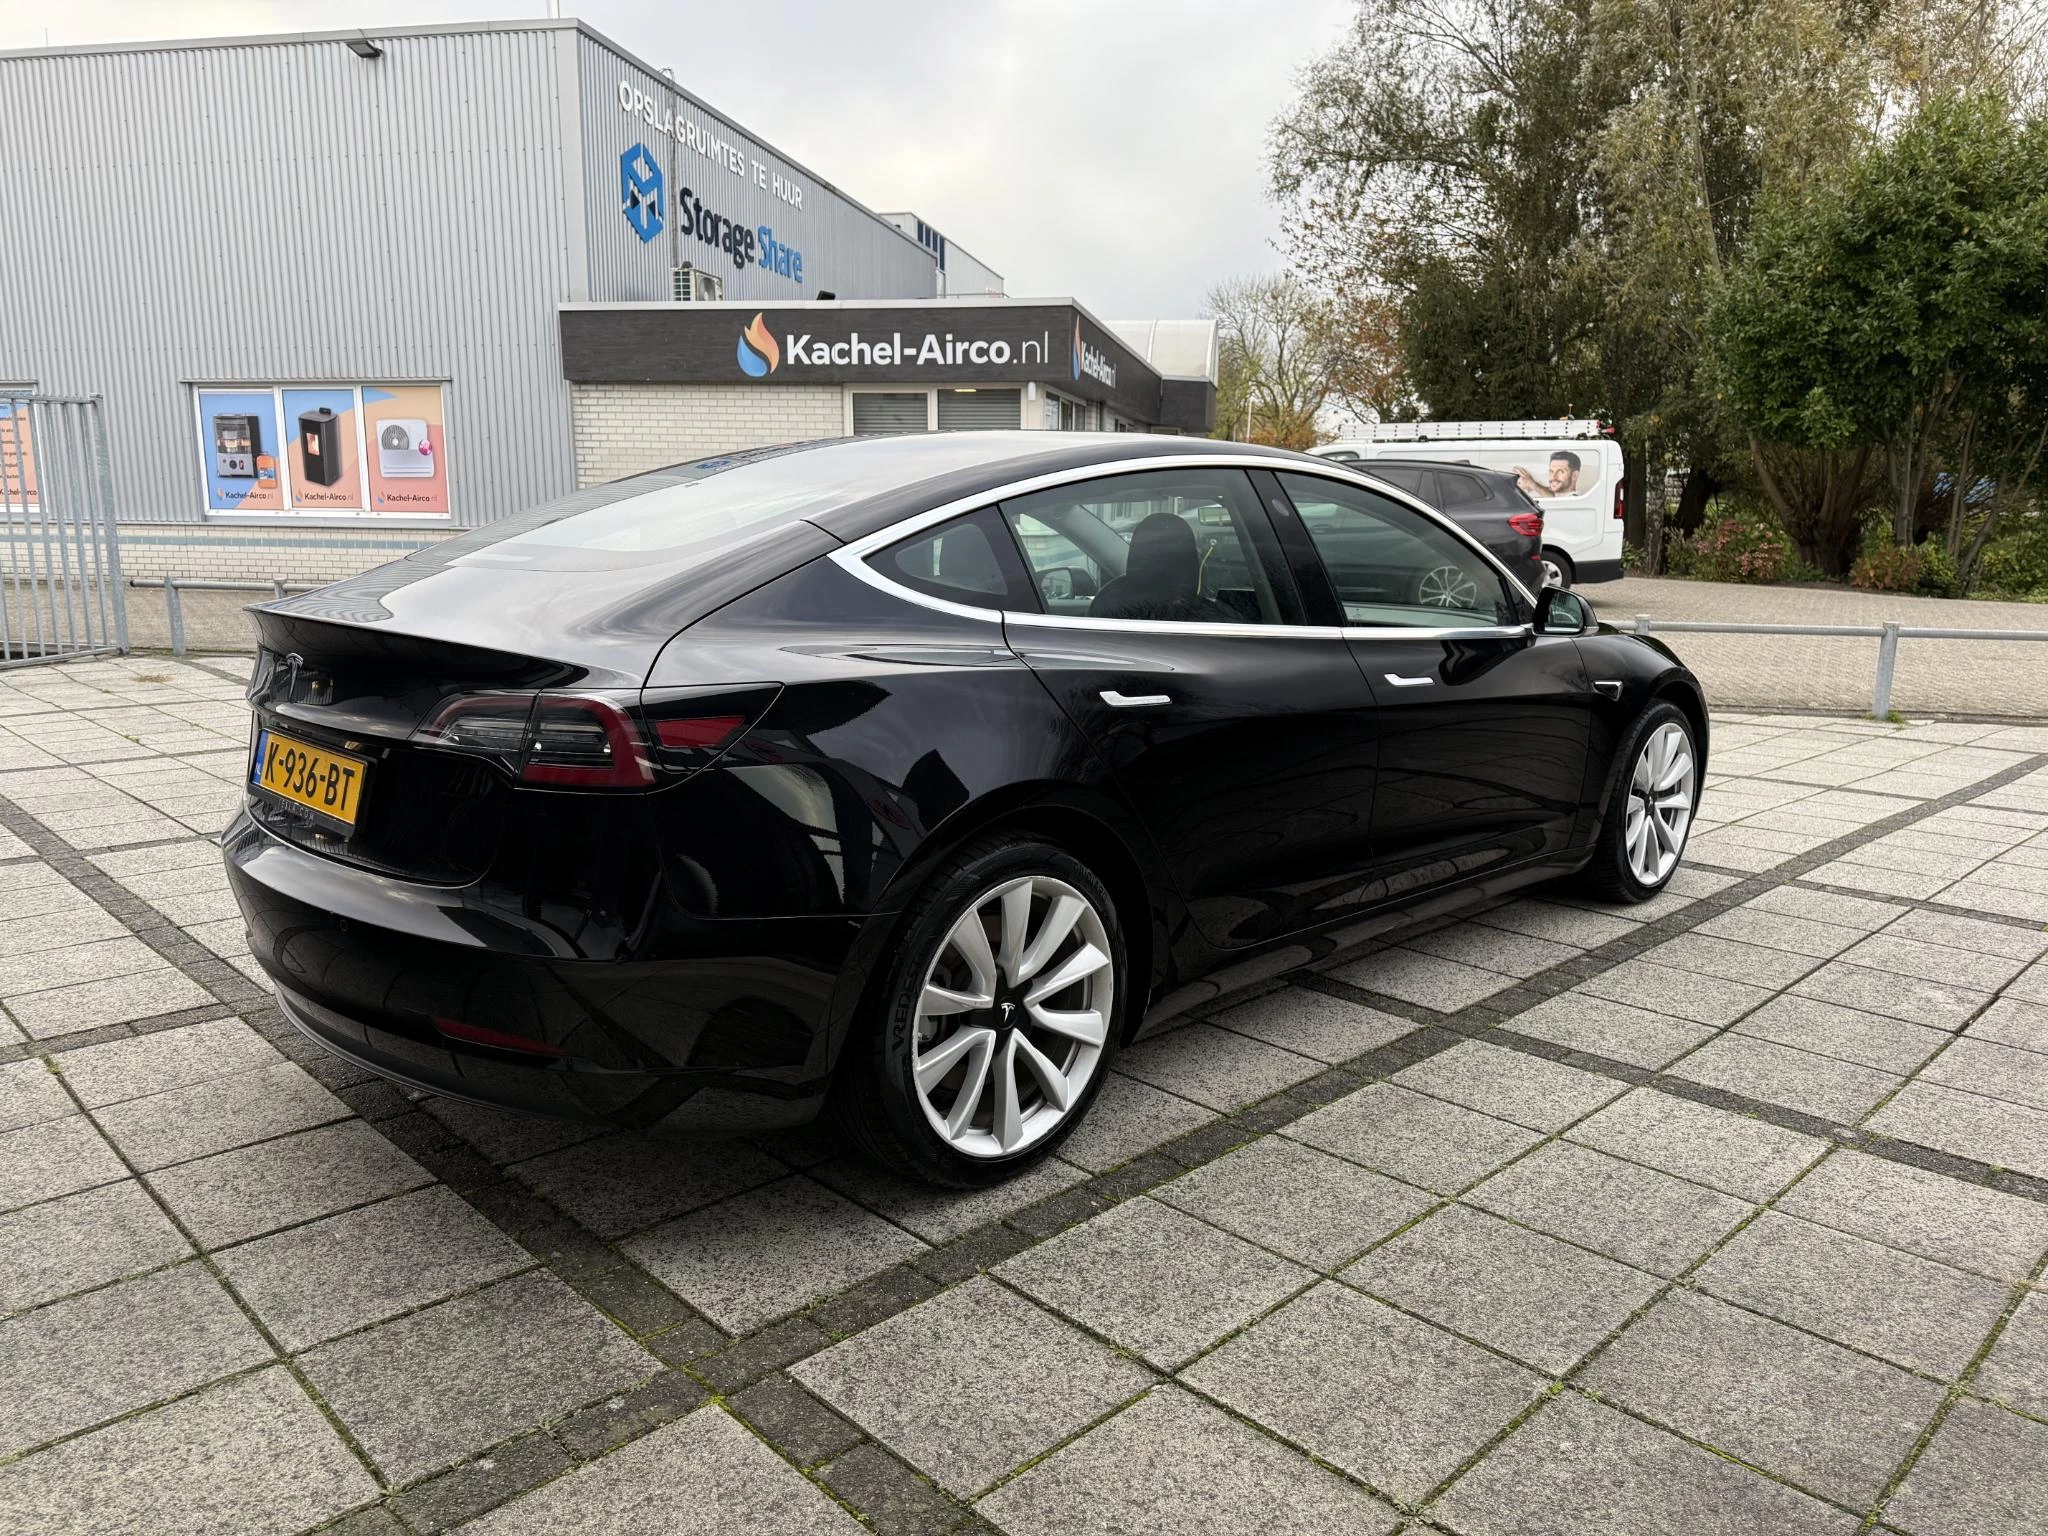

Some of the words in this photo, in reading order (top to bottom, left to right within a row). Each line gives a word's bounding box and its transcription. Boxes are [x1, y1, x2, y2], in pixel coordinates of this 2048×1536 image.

[618, 80, 745, 177] OPSLAGRUIMTES
[751, 159, 767, 190] TE
[772, 171, 802, 210] HUUR
[679, 187, 755, 269] Storage
[757, 225, 803, 284] Share
[786, 331, 1049, 366] Kachel-Airco.nl
[265, 741, 355, 811] K-936-BT
